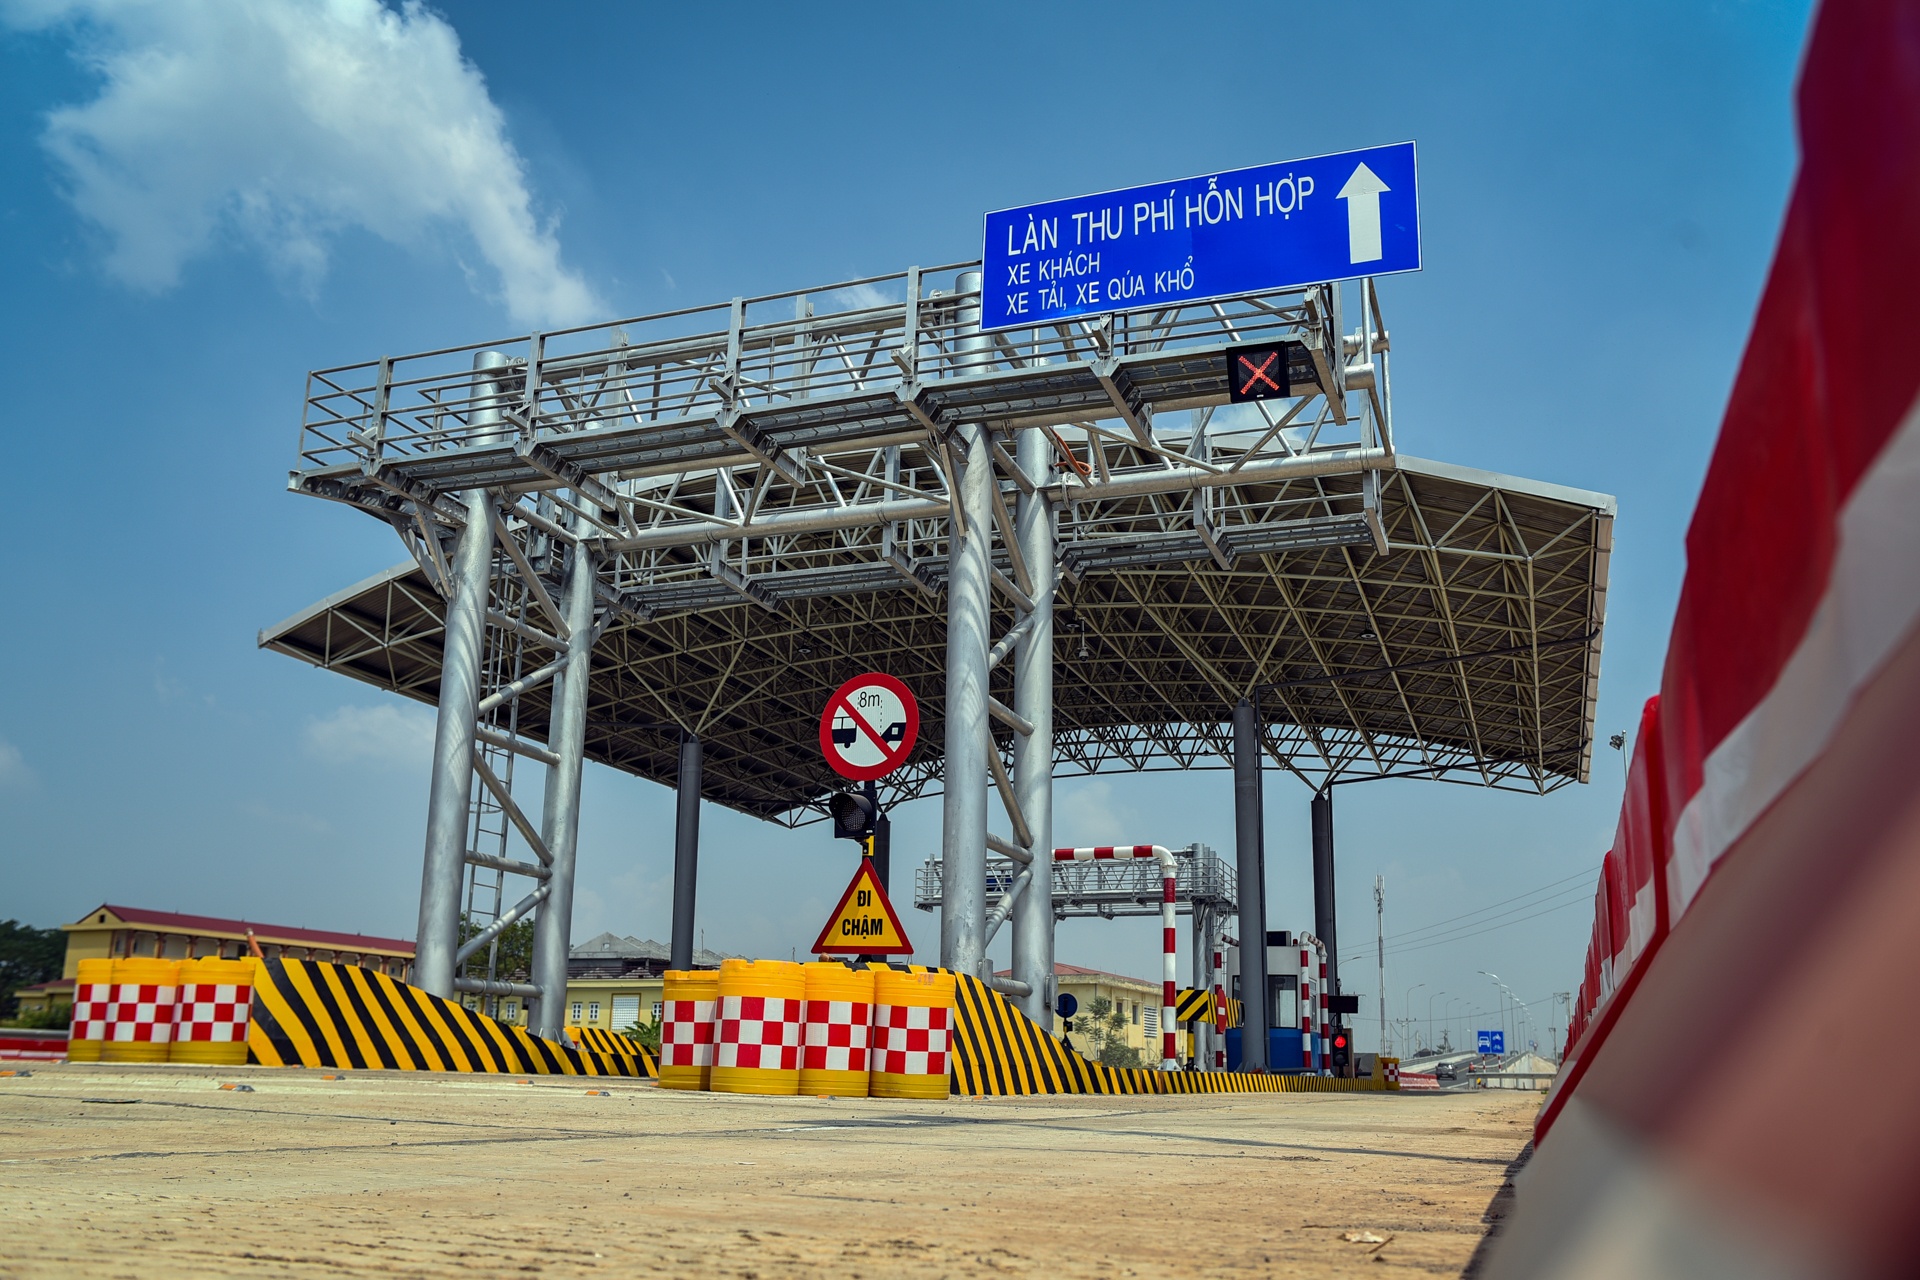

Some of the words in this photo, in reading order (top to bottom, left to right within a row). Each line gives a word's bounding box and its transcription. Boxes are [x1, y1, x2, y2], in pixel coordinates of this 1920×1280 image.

[1007, 213, 1058, 256] LÀN
[1071, 205, 1123, 245] THU
[1133, 189, 1176, 236] PHÍ
[1185, 176, 1243, 228] HỖN
[1255, 172, 1315, 220] HỢP
[1007, 262, 1031, 286] XE
[1039, 250, 1100, 281] KHÁCH
[1006, 291, 1029, 316] XE
[1038, 280, 1067, 311] TẢI,
[1075, 281, 1100, 305] XE
[1107, 269, 1146, 301] QÚA
[1154, 255, 1195, 294] KHỔ
[859, 691, 880, 708] 8m
[857, 890, 872, 907] ĐI
[841, 914, 883, 940] CHẬM
